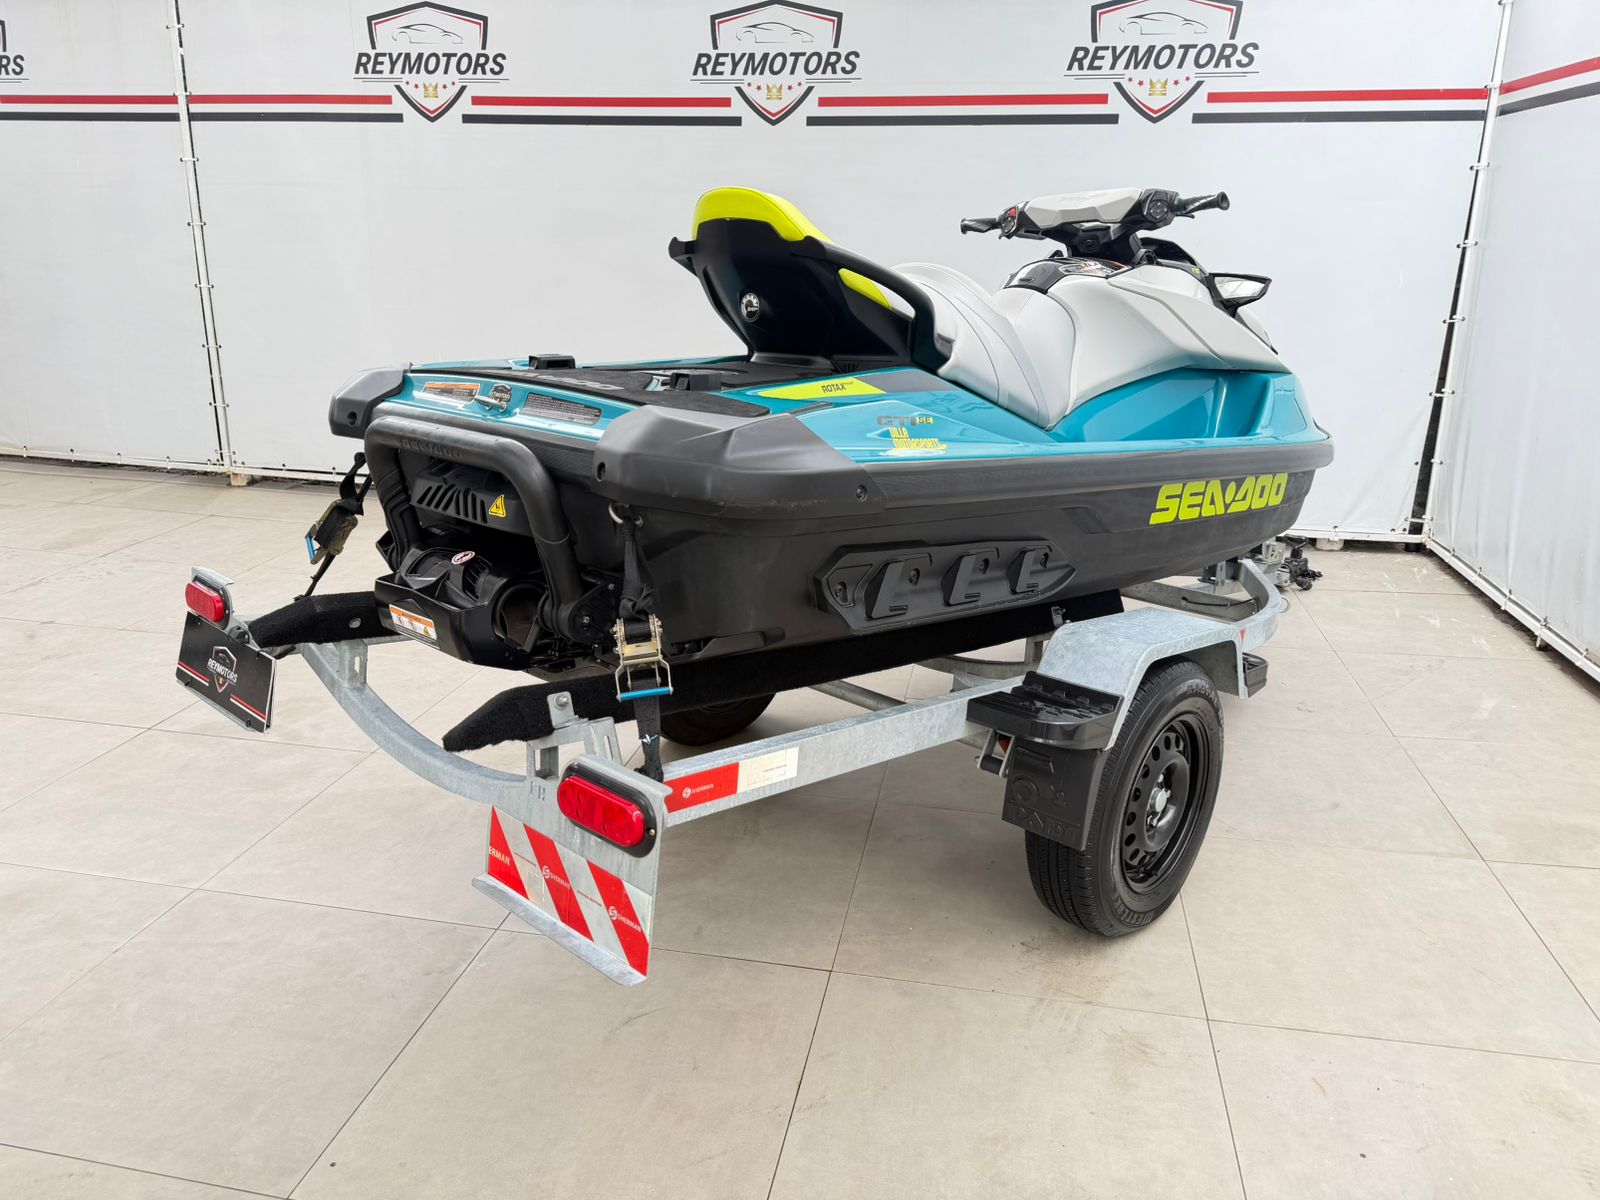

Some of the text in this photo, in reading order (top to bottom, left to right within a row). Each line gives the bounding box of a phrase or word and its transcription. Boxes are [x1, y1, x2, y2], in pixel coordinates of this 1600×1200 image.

[354, 52, 507, 75] REYMOTORS
[692, 50, 861, 76] REYMOTORS
[1066, 42, 1260, 71] REYMOTORS
[821, 383, 847, 394] ROTAX
[877, 416, 916, 427] GTI
[207, 658, 238, 683] REYMOTORS
[550, 872, 571, 890] SHERMAN
[617, 913, 641, 932] SHERMAN
